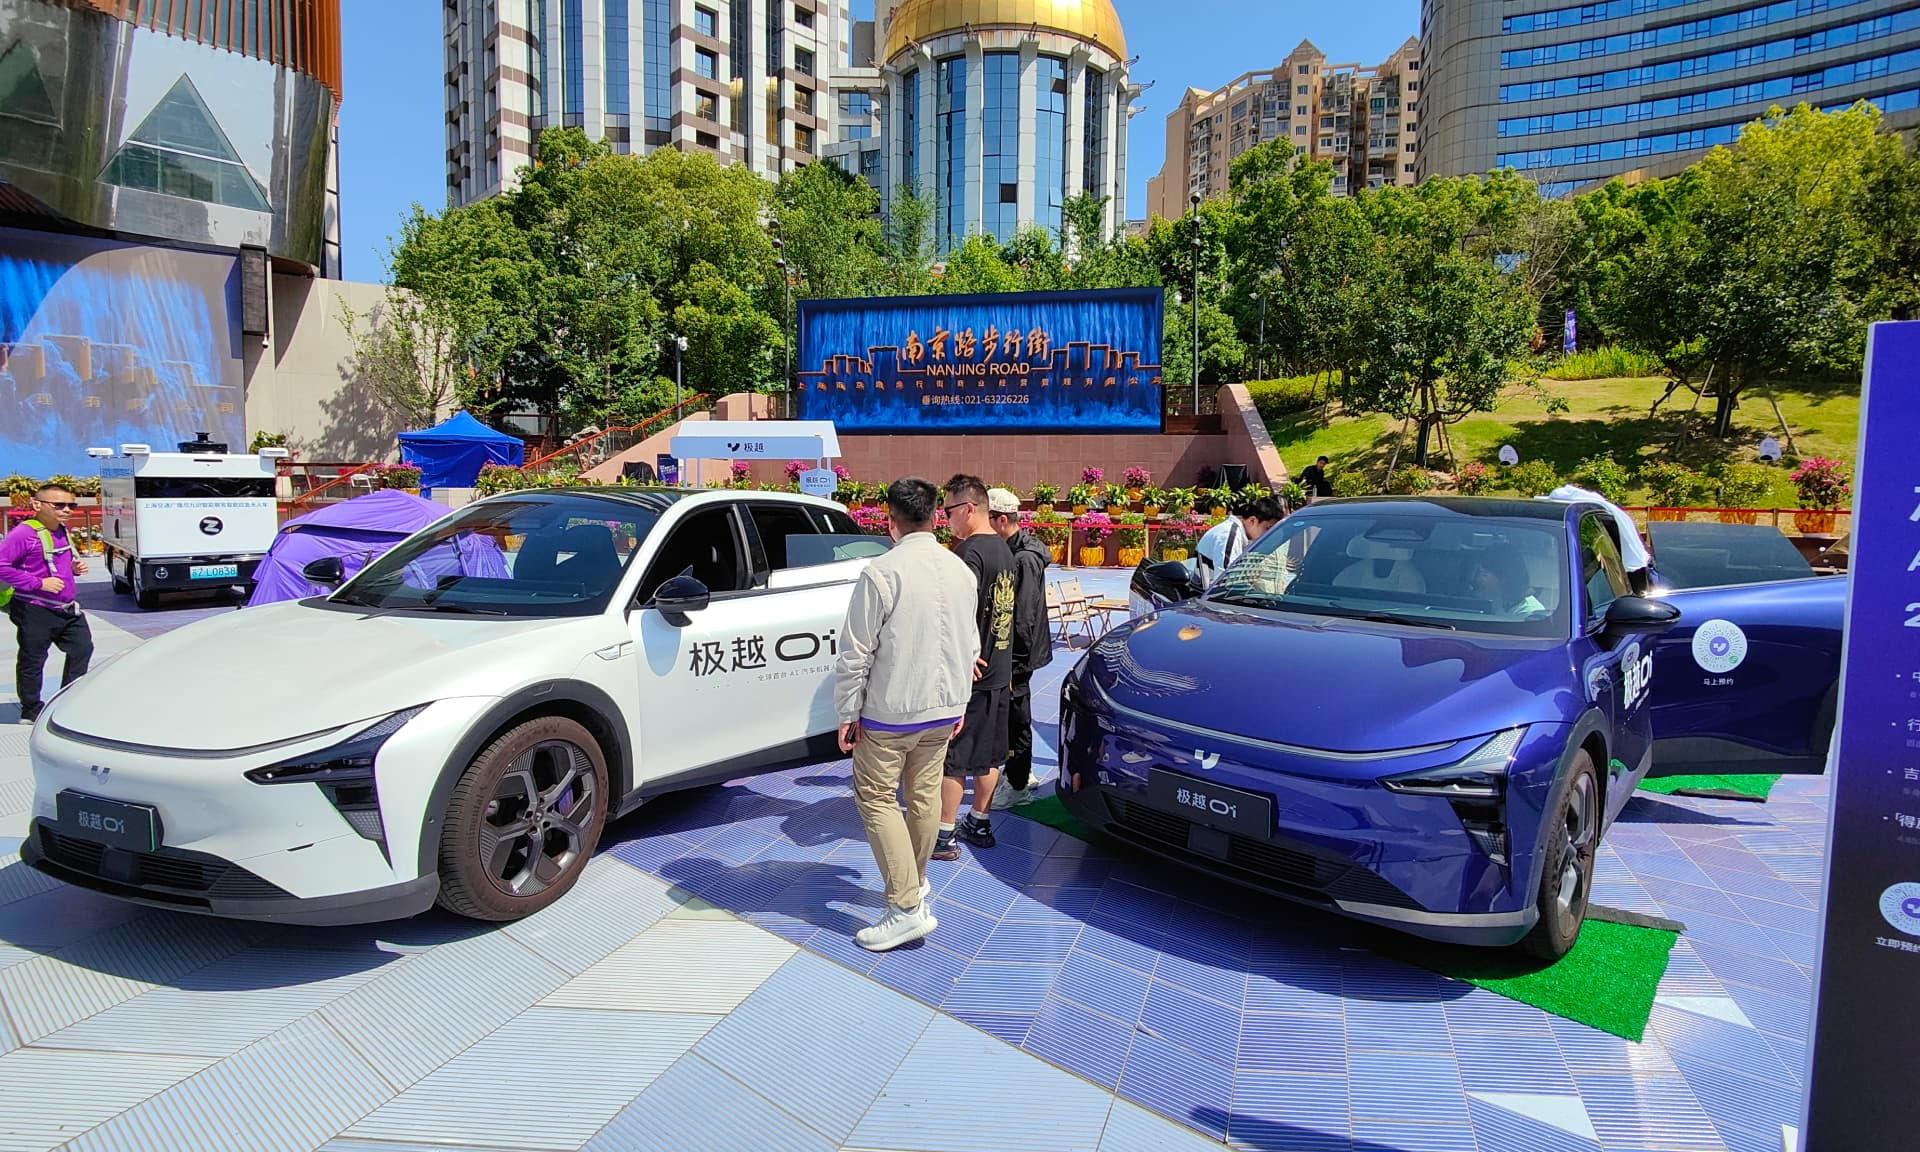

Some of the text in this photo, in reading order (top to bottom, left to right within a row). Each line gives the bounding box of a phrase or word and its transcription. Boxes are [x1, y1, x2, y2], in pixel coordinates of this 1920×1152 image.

[902, 324, 1051, 366] 南京路步行街
[926, 362, 1030, 377] NANJING ROAD
[743, 442, 764, 453] 极越
